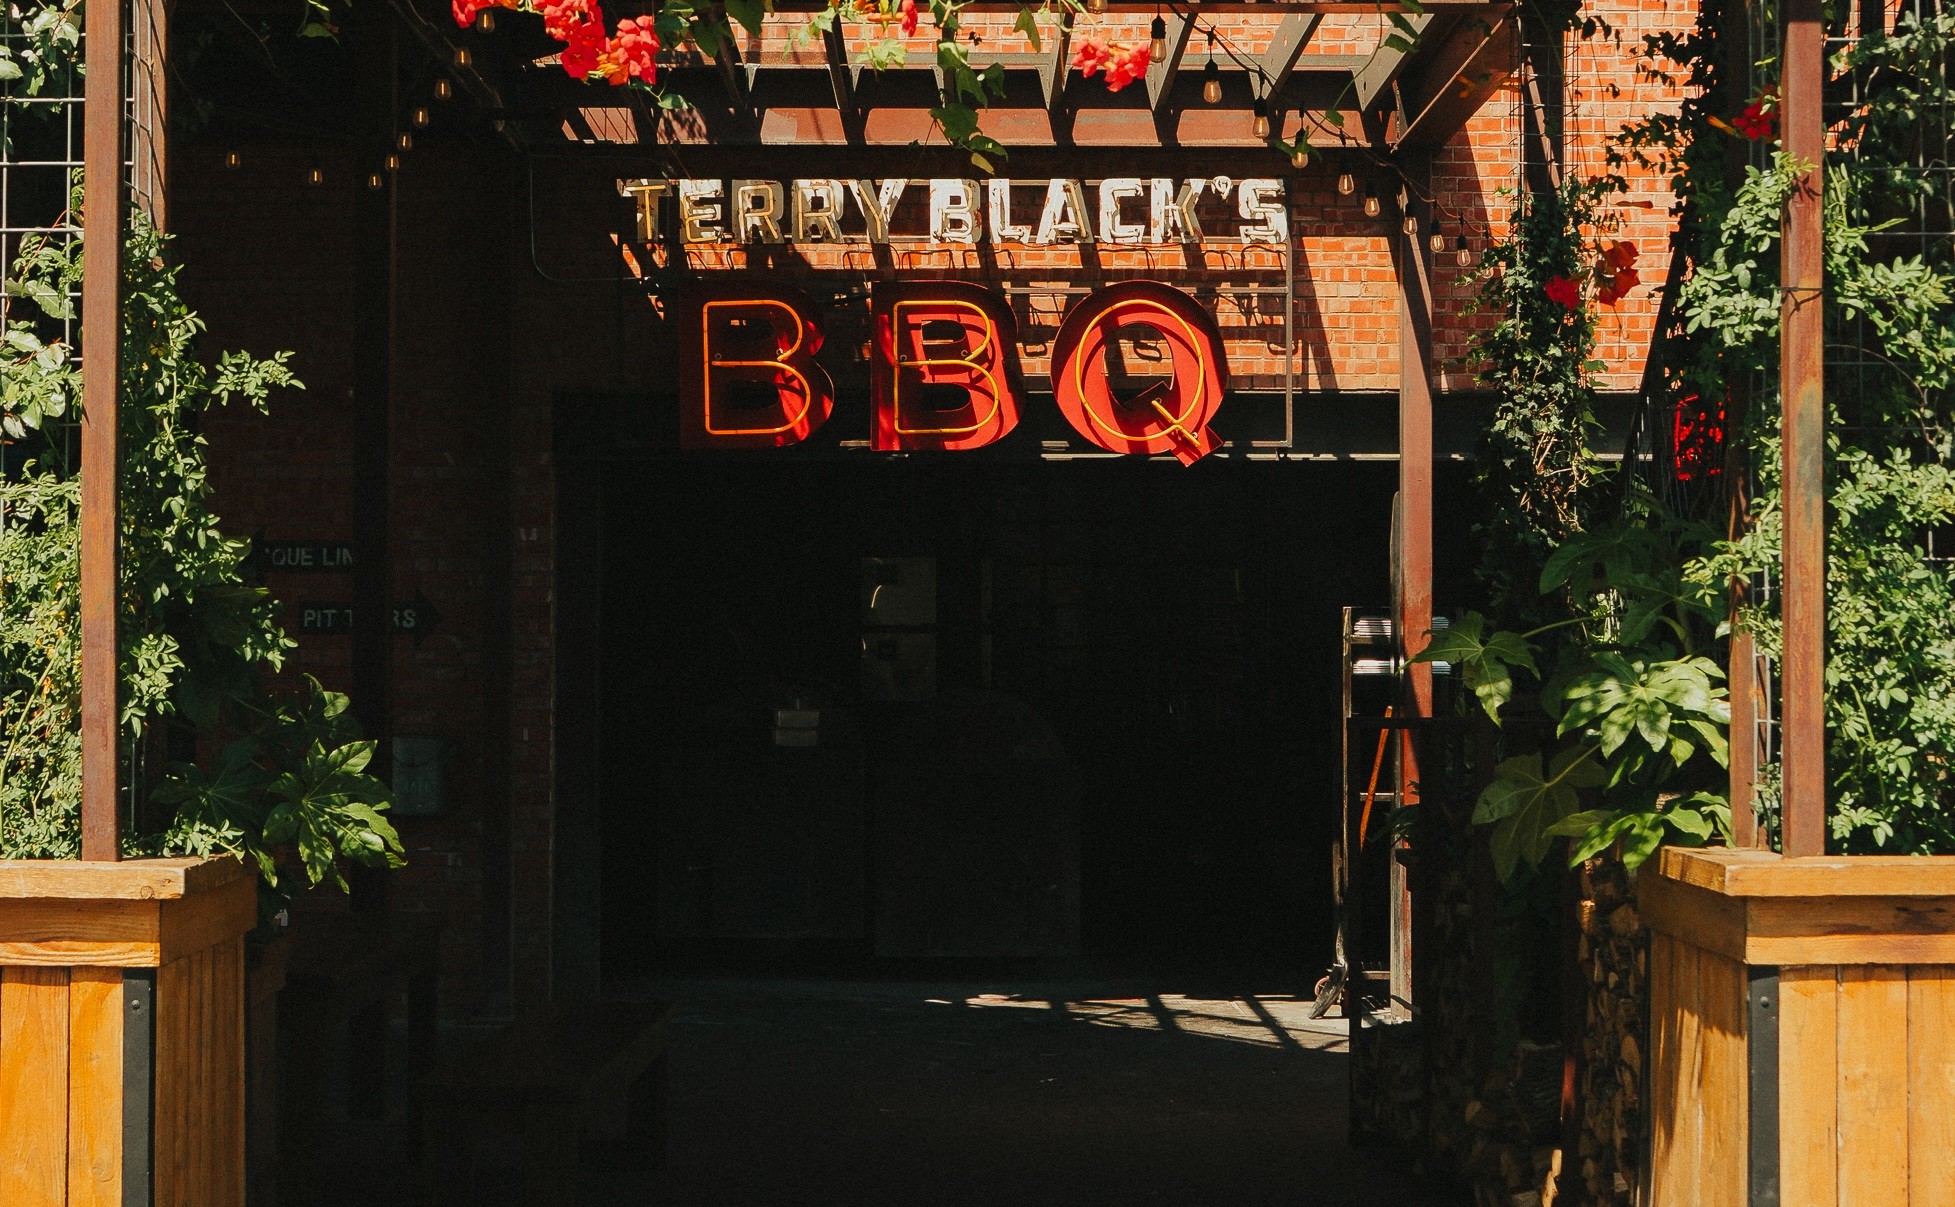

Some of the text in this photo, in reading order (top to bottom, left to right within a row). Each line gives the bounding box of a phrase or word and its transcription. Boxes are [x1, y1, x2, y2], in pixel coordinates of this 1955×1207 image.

[617, 176, 1288, 244] TERRY BLACK'S
[680, 280, 1228, 467] BBQ
[322, 547, 353, 566] LIN
[303, 608, 417, 629] PIT TRS
